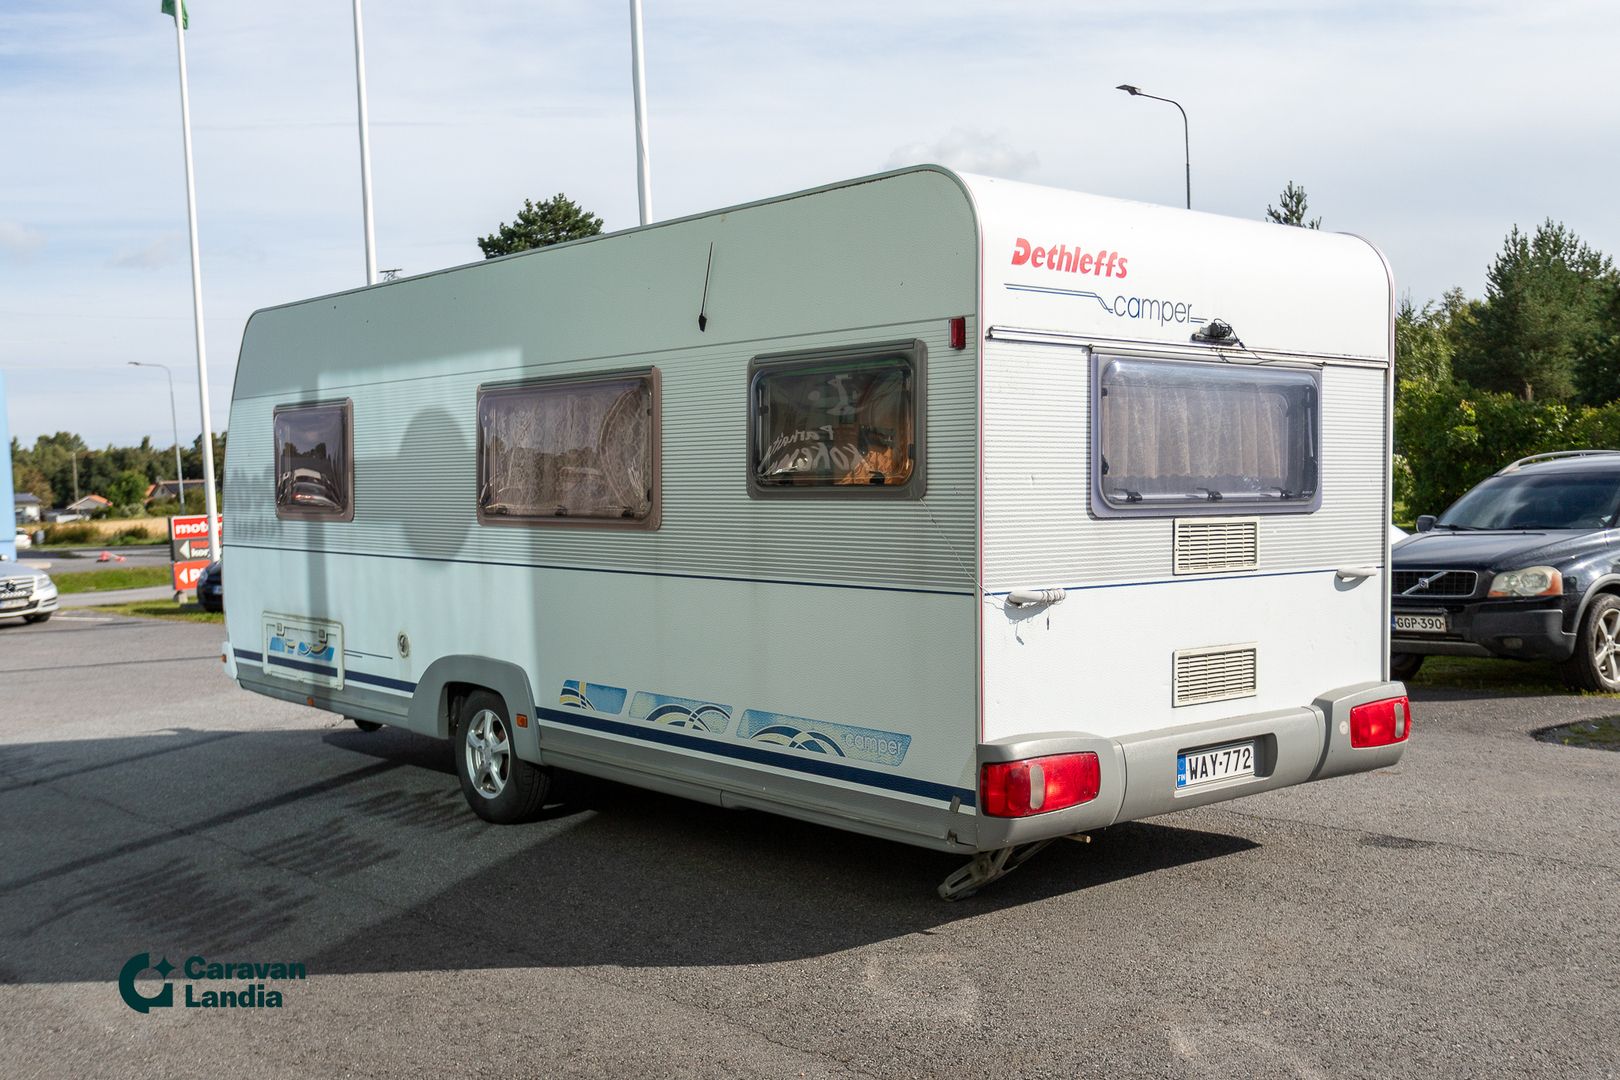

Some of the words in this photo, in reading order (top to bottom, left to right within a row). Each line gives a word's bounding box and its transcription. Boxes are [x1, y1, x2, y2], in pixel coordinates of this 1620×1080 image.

[1011, 237, 1128, 279] Dethleffs
[1113, 295, 1192, 326] camper
[175, 520, 209, 535] mot
[1397, 617, 1442, 630] GGP-390
[845, 732, 903, 756] camper
[1188, 747, 1251, 780] WAY-772
[1178, 774, 1186, 782] FIN
